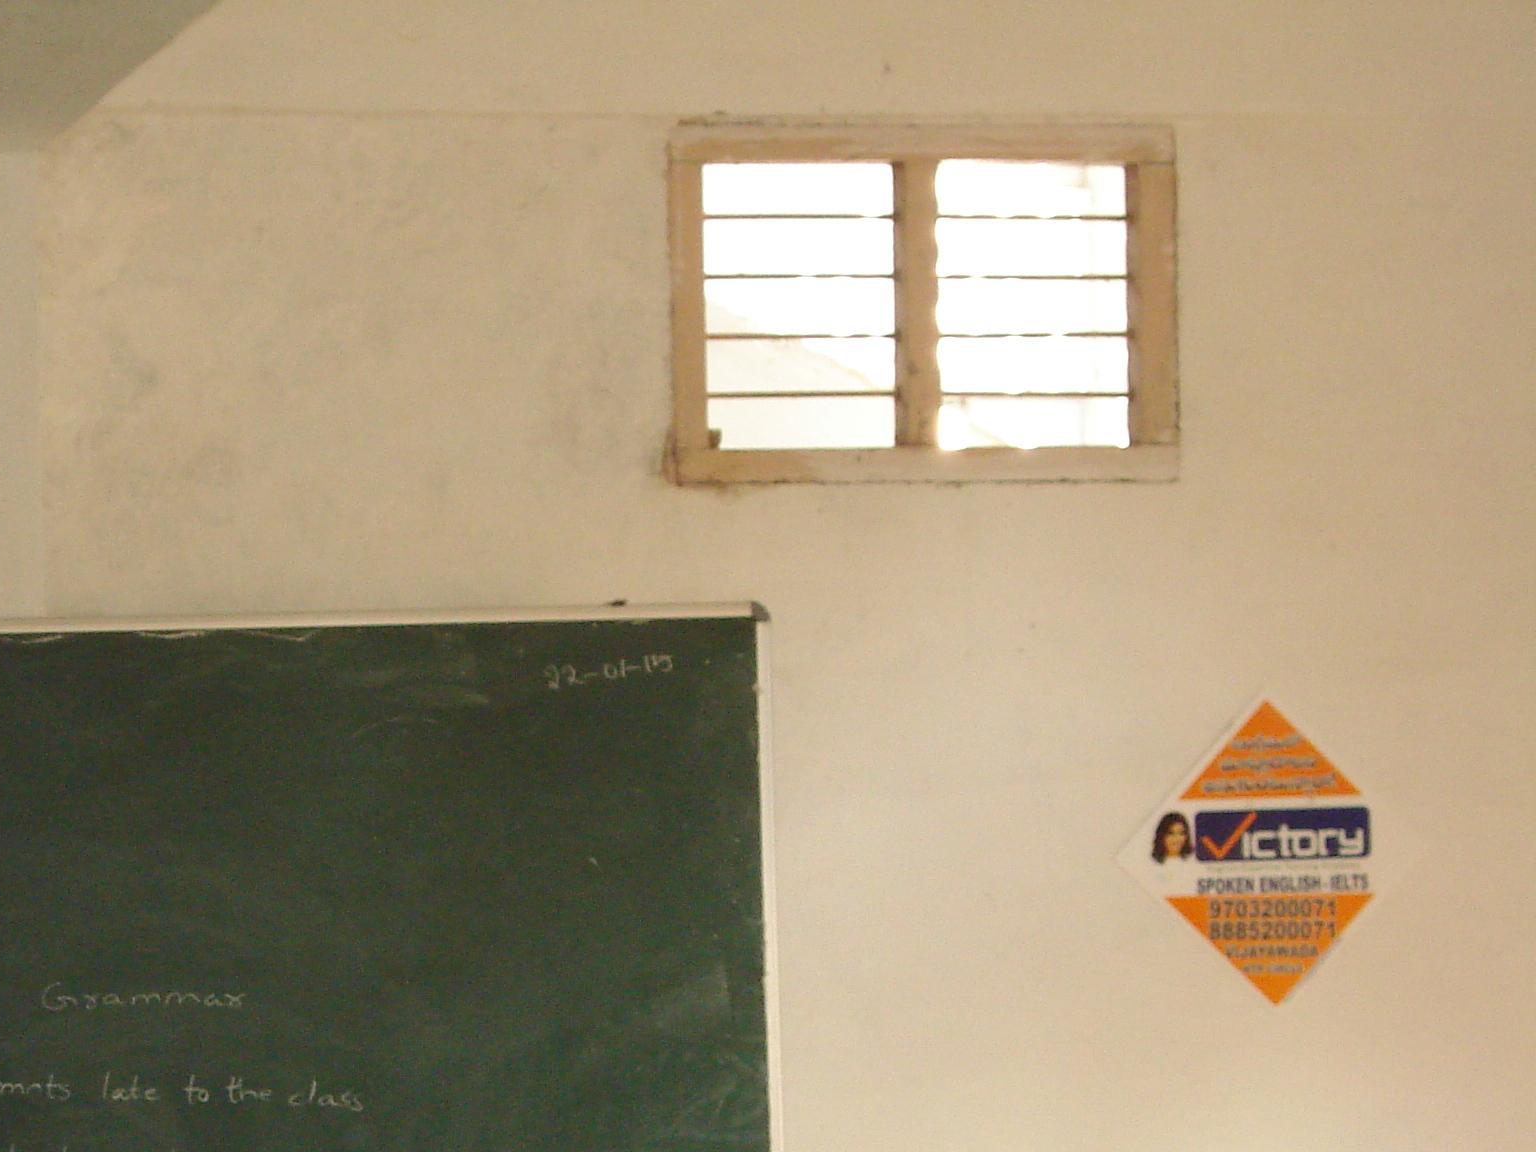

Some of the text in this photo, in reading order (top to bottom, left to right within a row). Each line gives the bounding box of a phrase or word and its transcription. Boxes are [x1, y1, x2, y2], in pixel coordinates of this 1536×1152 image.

[1197, 876, 1254, 894] SPOKEN
[1209, 899, 1336, 918] 9703200071
[1209, 920, 1336, 940] 8885200071
[103, 1071, 160, 1101] late
[184, 1074, 210, 1104] to
[225, 1076, 272, 1104] the
[288, 1079, 364, 1112] class
